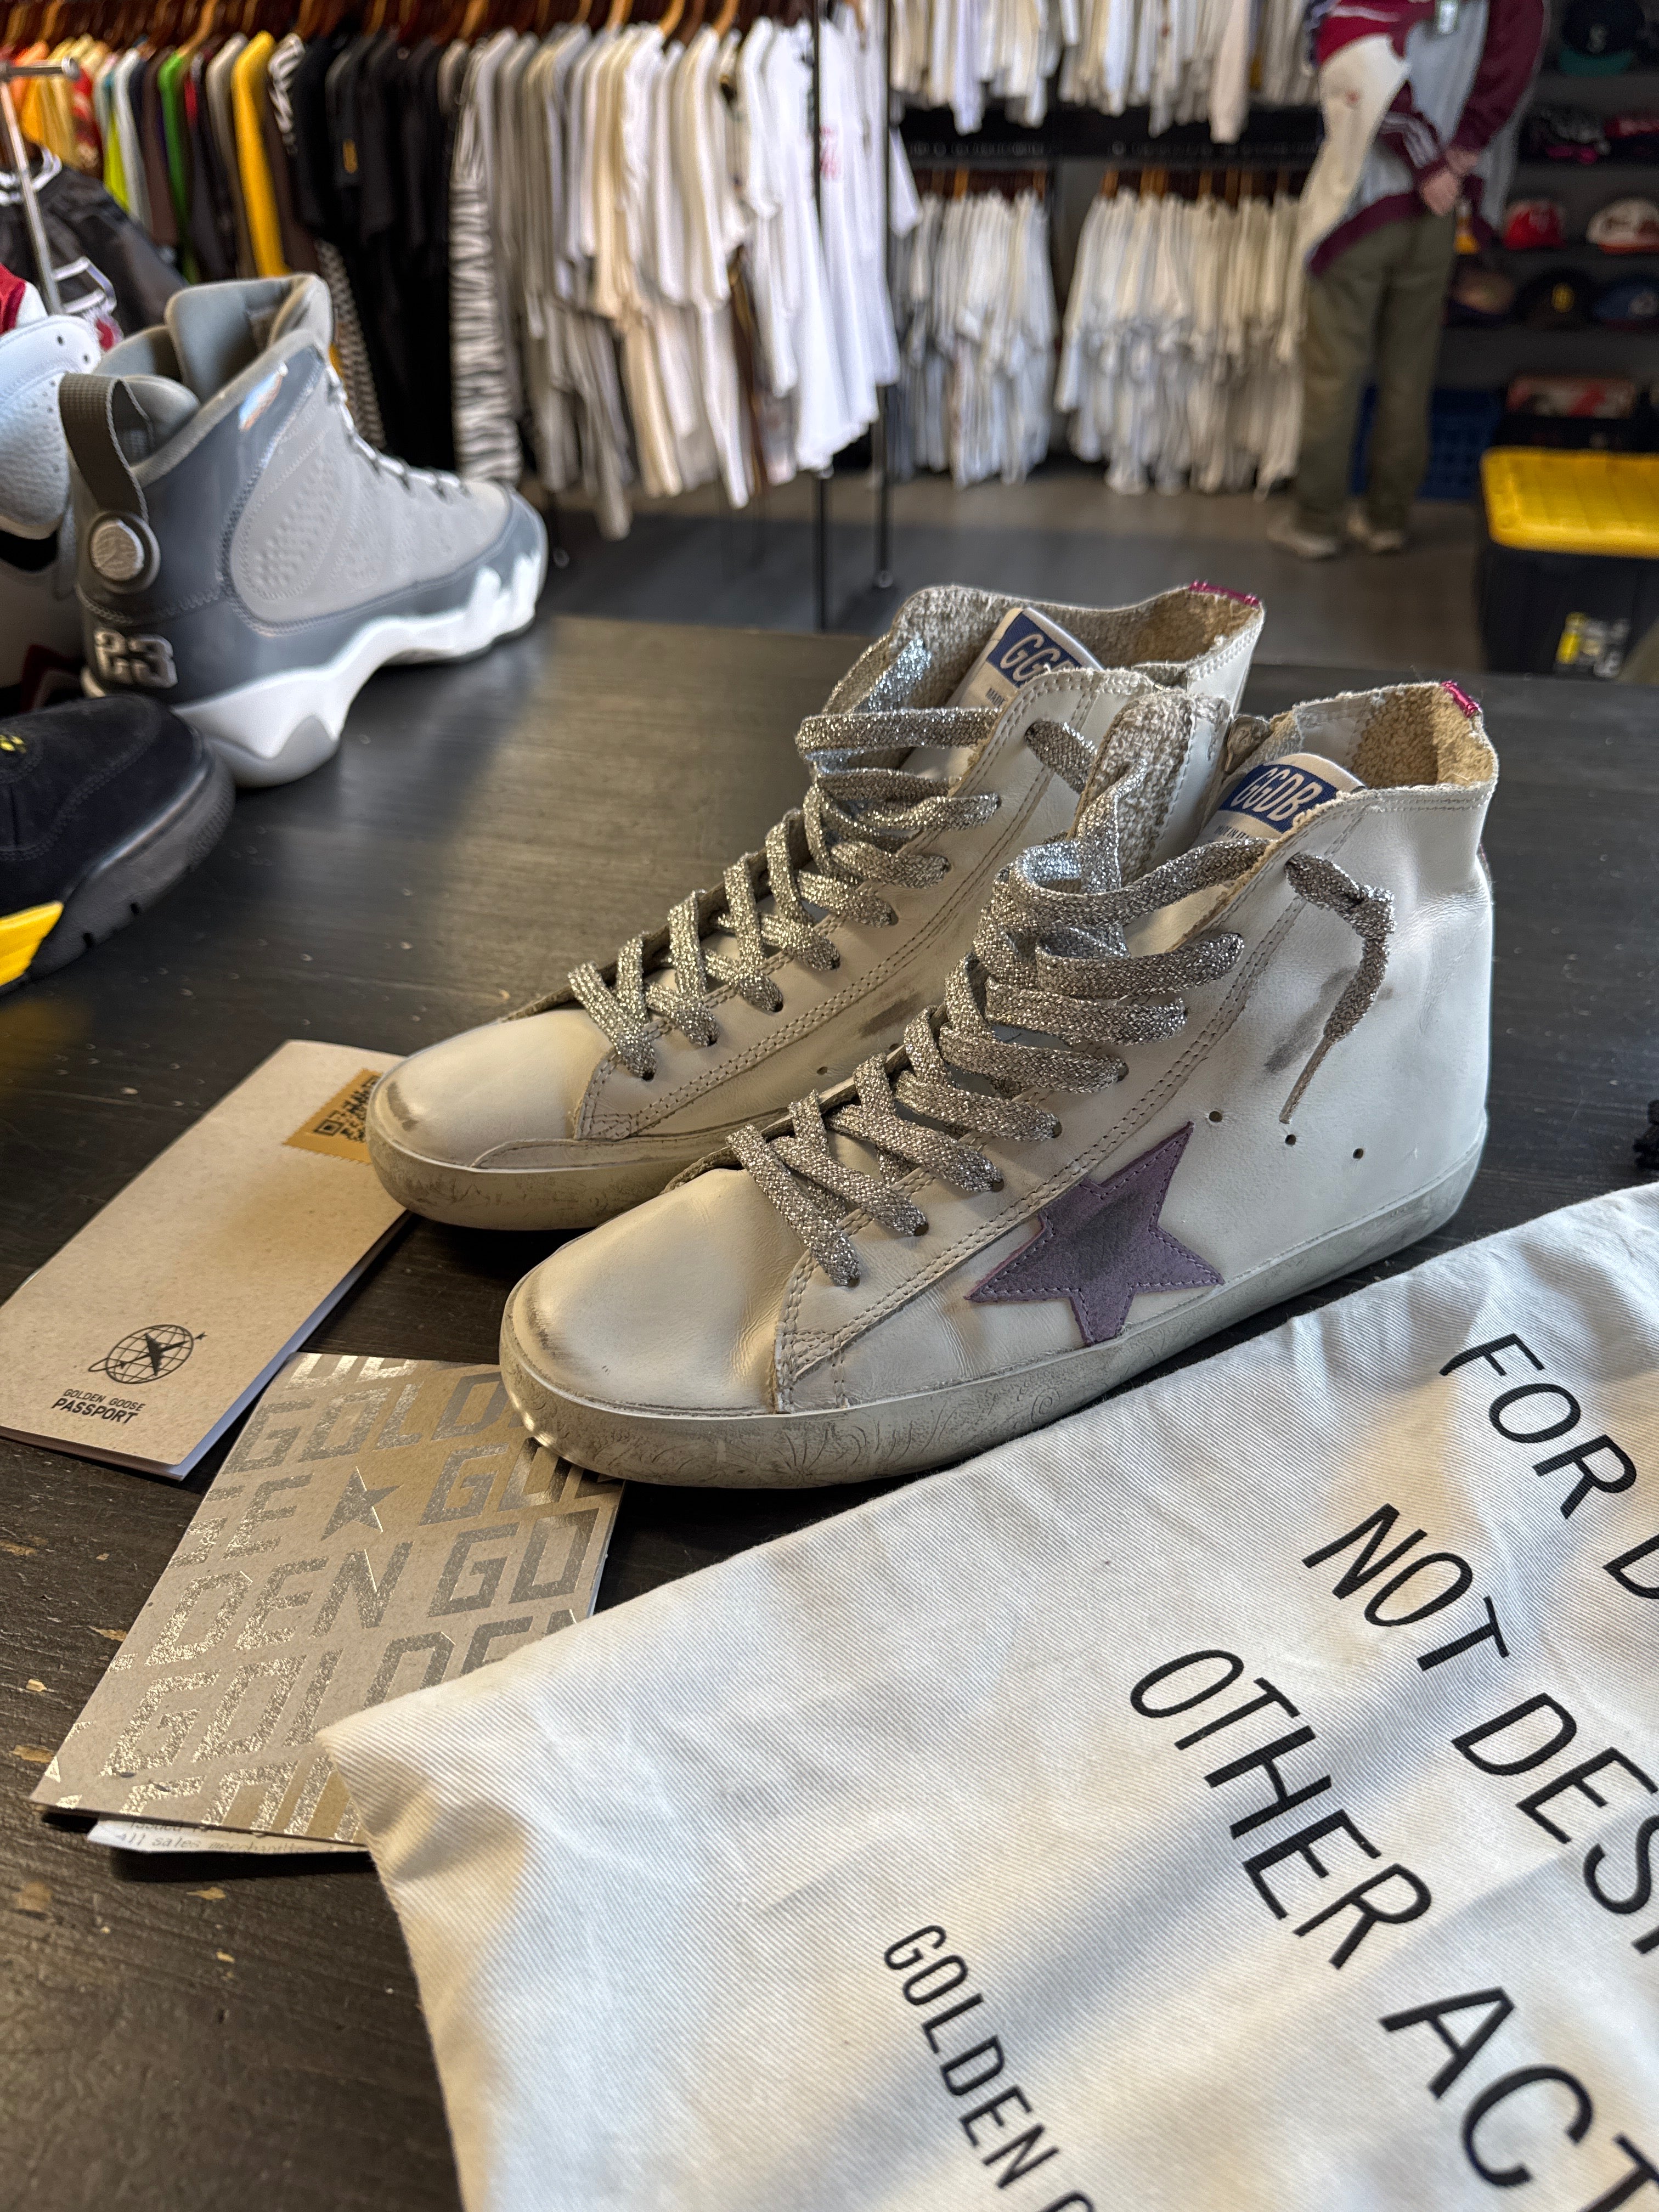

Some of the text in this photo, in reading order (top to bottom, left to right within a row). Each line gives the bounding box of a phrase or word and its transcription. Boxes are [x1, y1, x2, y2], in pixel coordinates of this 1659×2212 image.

[1230, 767, 1323, 822] GGDB
[51, 1397, 138, 1424] PASSPORT
[63, 1389, 146, 1412] GOLDEN GOOSE
[221, 1372, 524, 1475] GOLD
[1438, 1332, 1637, 1520] FOR
[1301, 1503, 1510, 1671] NOT
[151, 1836, 201, 1848] sales
[1130, 1649, 1432, 1970] OTHER
[884, 1925, 1060, 2190] GOLDEN
